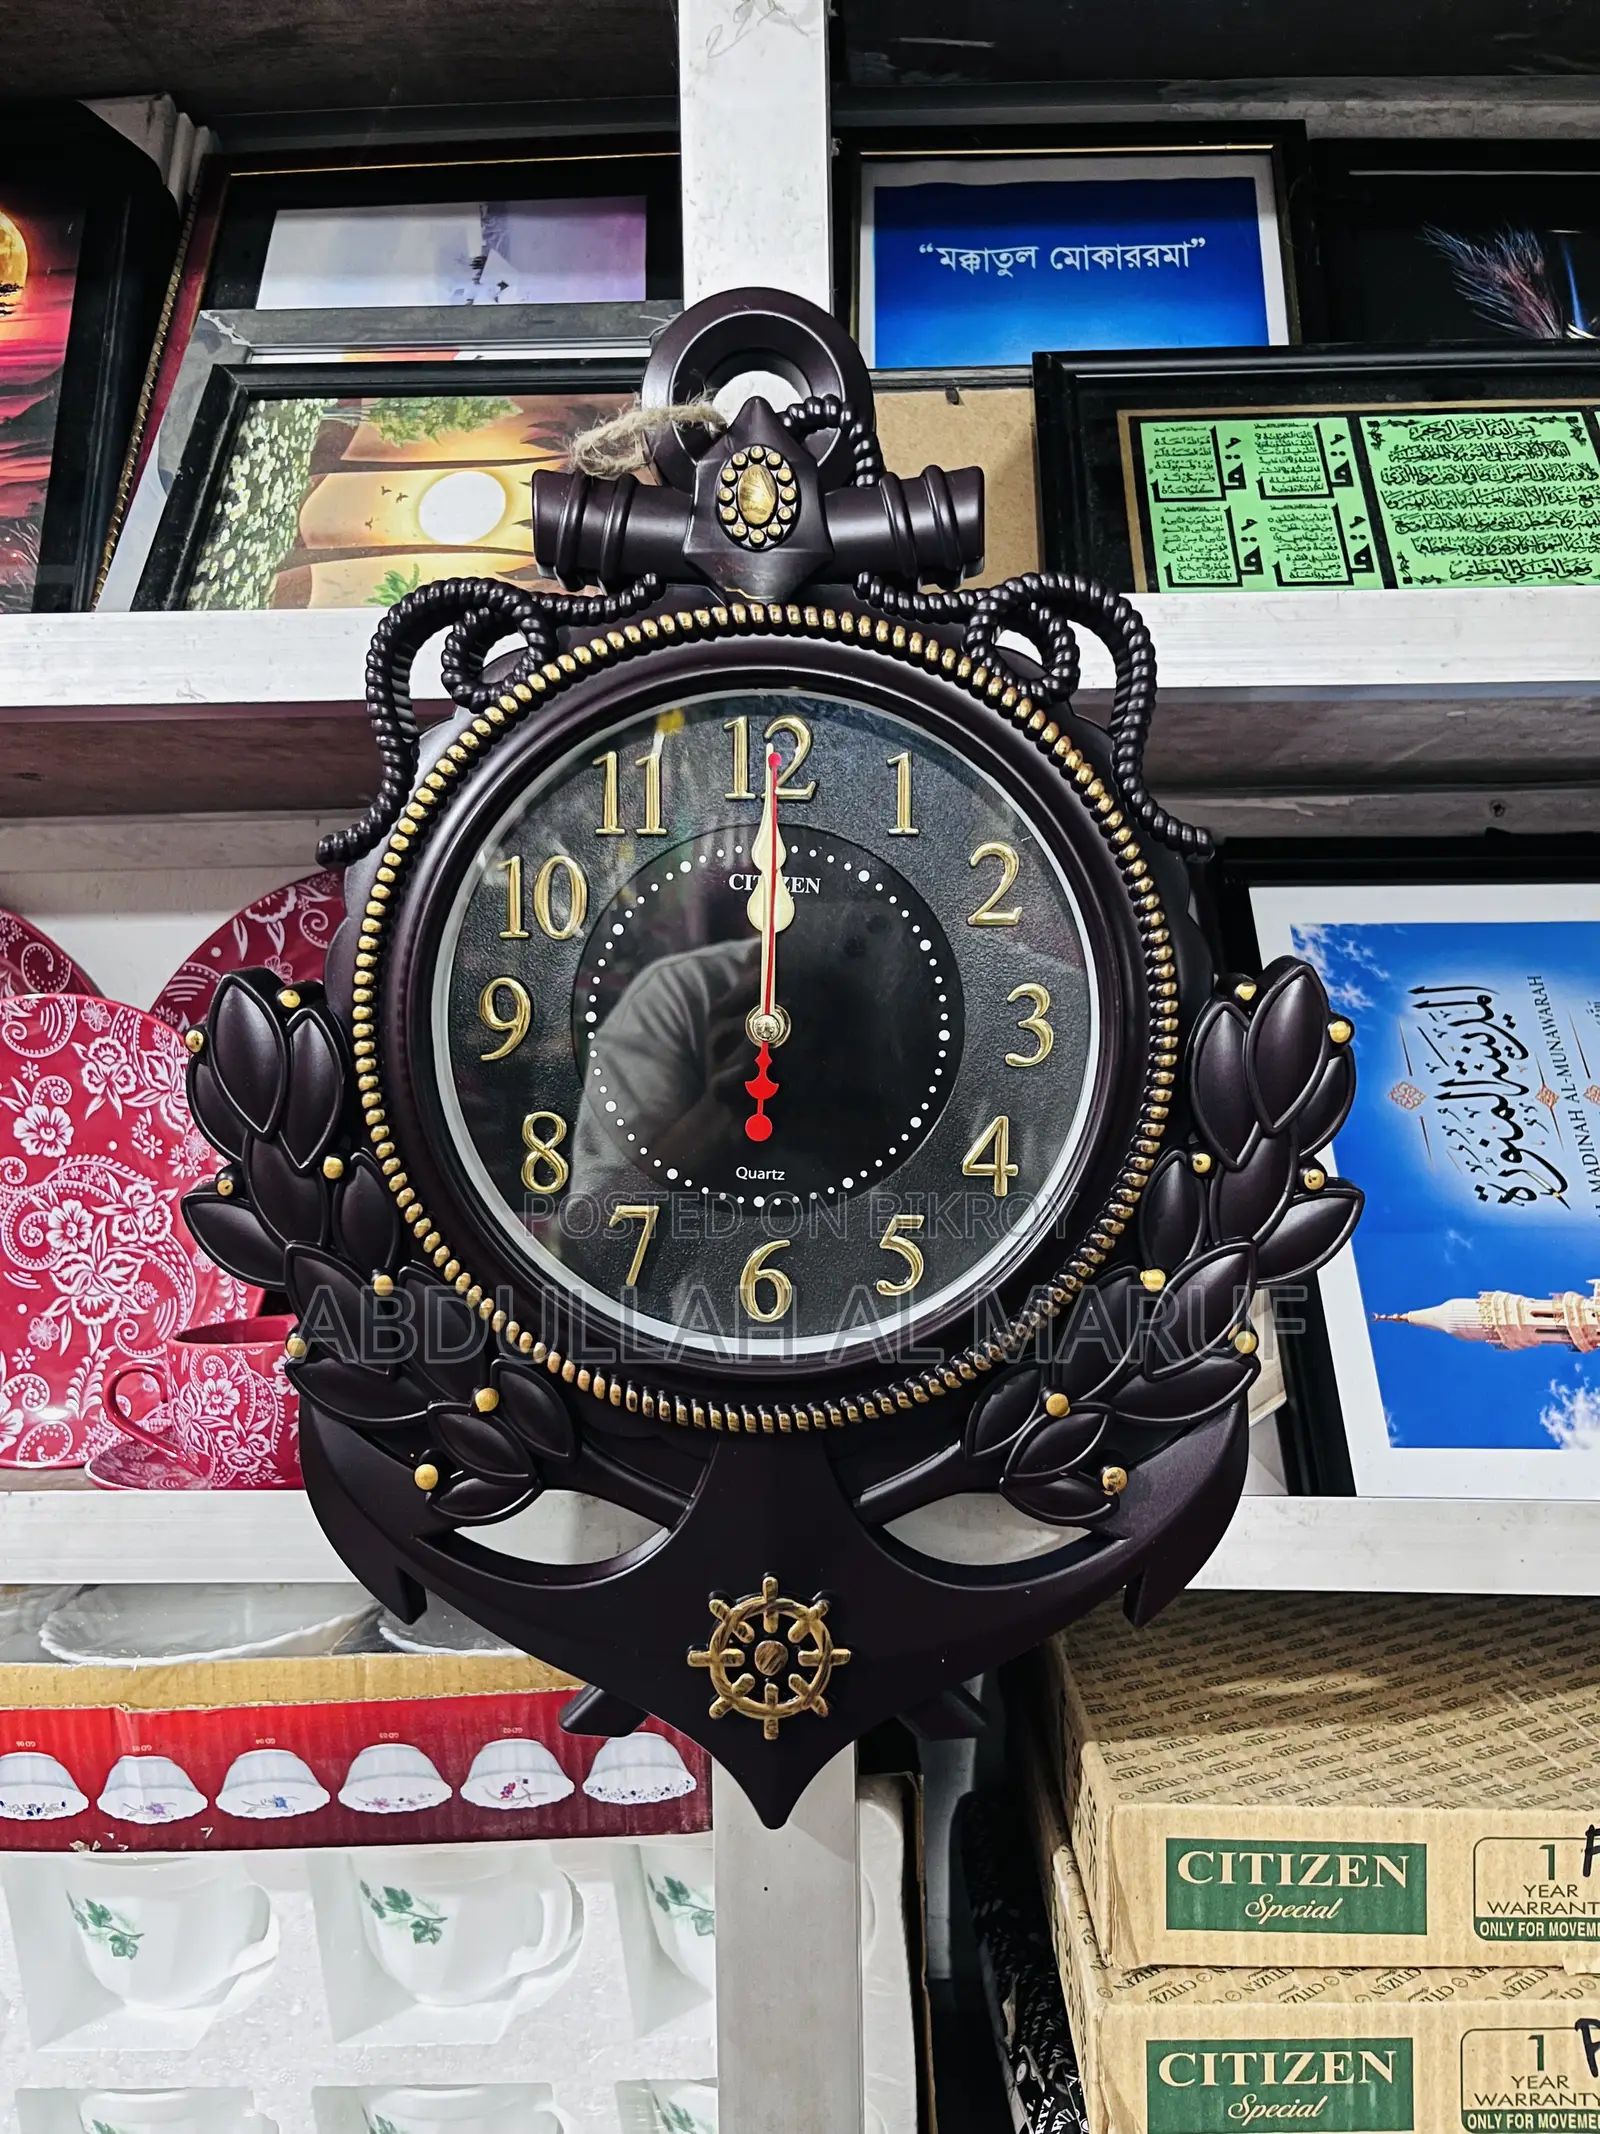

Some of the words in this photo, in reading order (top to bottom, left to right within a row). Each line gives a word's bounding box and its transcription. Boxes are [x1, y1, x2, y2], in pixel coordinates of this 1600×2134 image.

[593, 751, 668, 836] 11
[724, 715, 819, 800] 12
[886, 752, 920, 836] 1
[498, 855, 589, 940] 10
[967, 842, 1022, 926] 2
[478, 976, 532, 1062] 9
[1004, 982, 1053, 1067] 3
[1527, 975, 1578, 1103] AL-MUNAWARAH
[520, 1111, 569, 1193] 8
[735, 1165, 786, 1182] Quartz
[961, 1116, 1019, 1197] 4
[609, 1205, 660, 1286] 7
[739, 1239, 794, 1322] 6
[875, 1215, 925, 1295] 5
[1177, 1850, 1409, 1889] CITIZEN
[1523, 1884, 1579, 1898] YEAR
[1539, 1844, 1555, 1880] 1
[1244, 1893, 1343, 1925] Special
[1480, 1921, 1514, 1937] ONLY
[1518, 1921, 1545, 1937] FOR
[1549, 1921, 1600, 1937] MOVEM
[1158, 2050, 1396, 2087] CITIZEN
[1511, 2075, 1570, 2089] YEAR
[1528, 2034, 1544, 2071] 1
[1227, 2093, 1328, 2126] Special
[1467, 2113, 1502, 2130] ONLY
[1507, 2113, 1534, 2130] FOR
